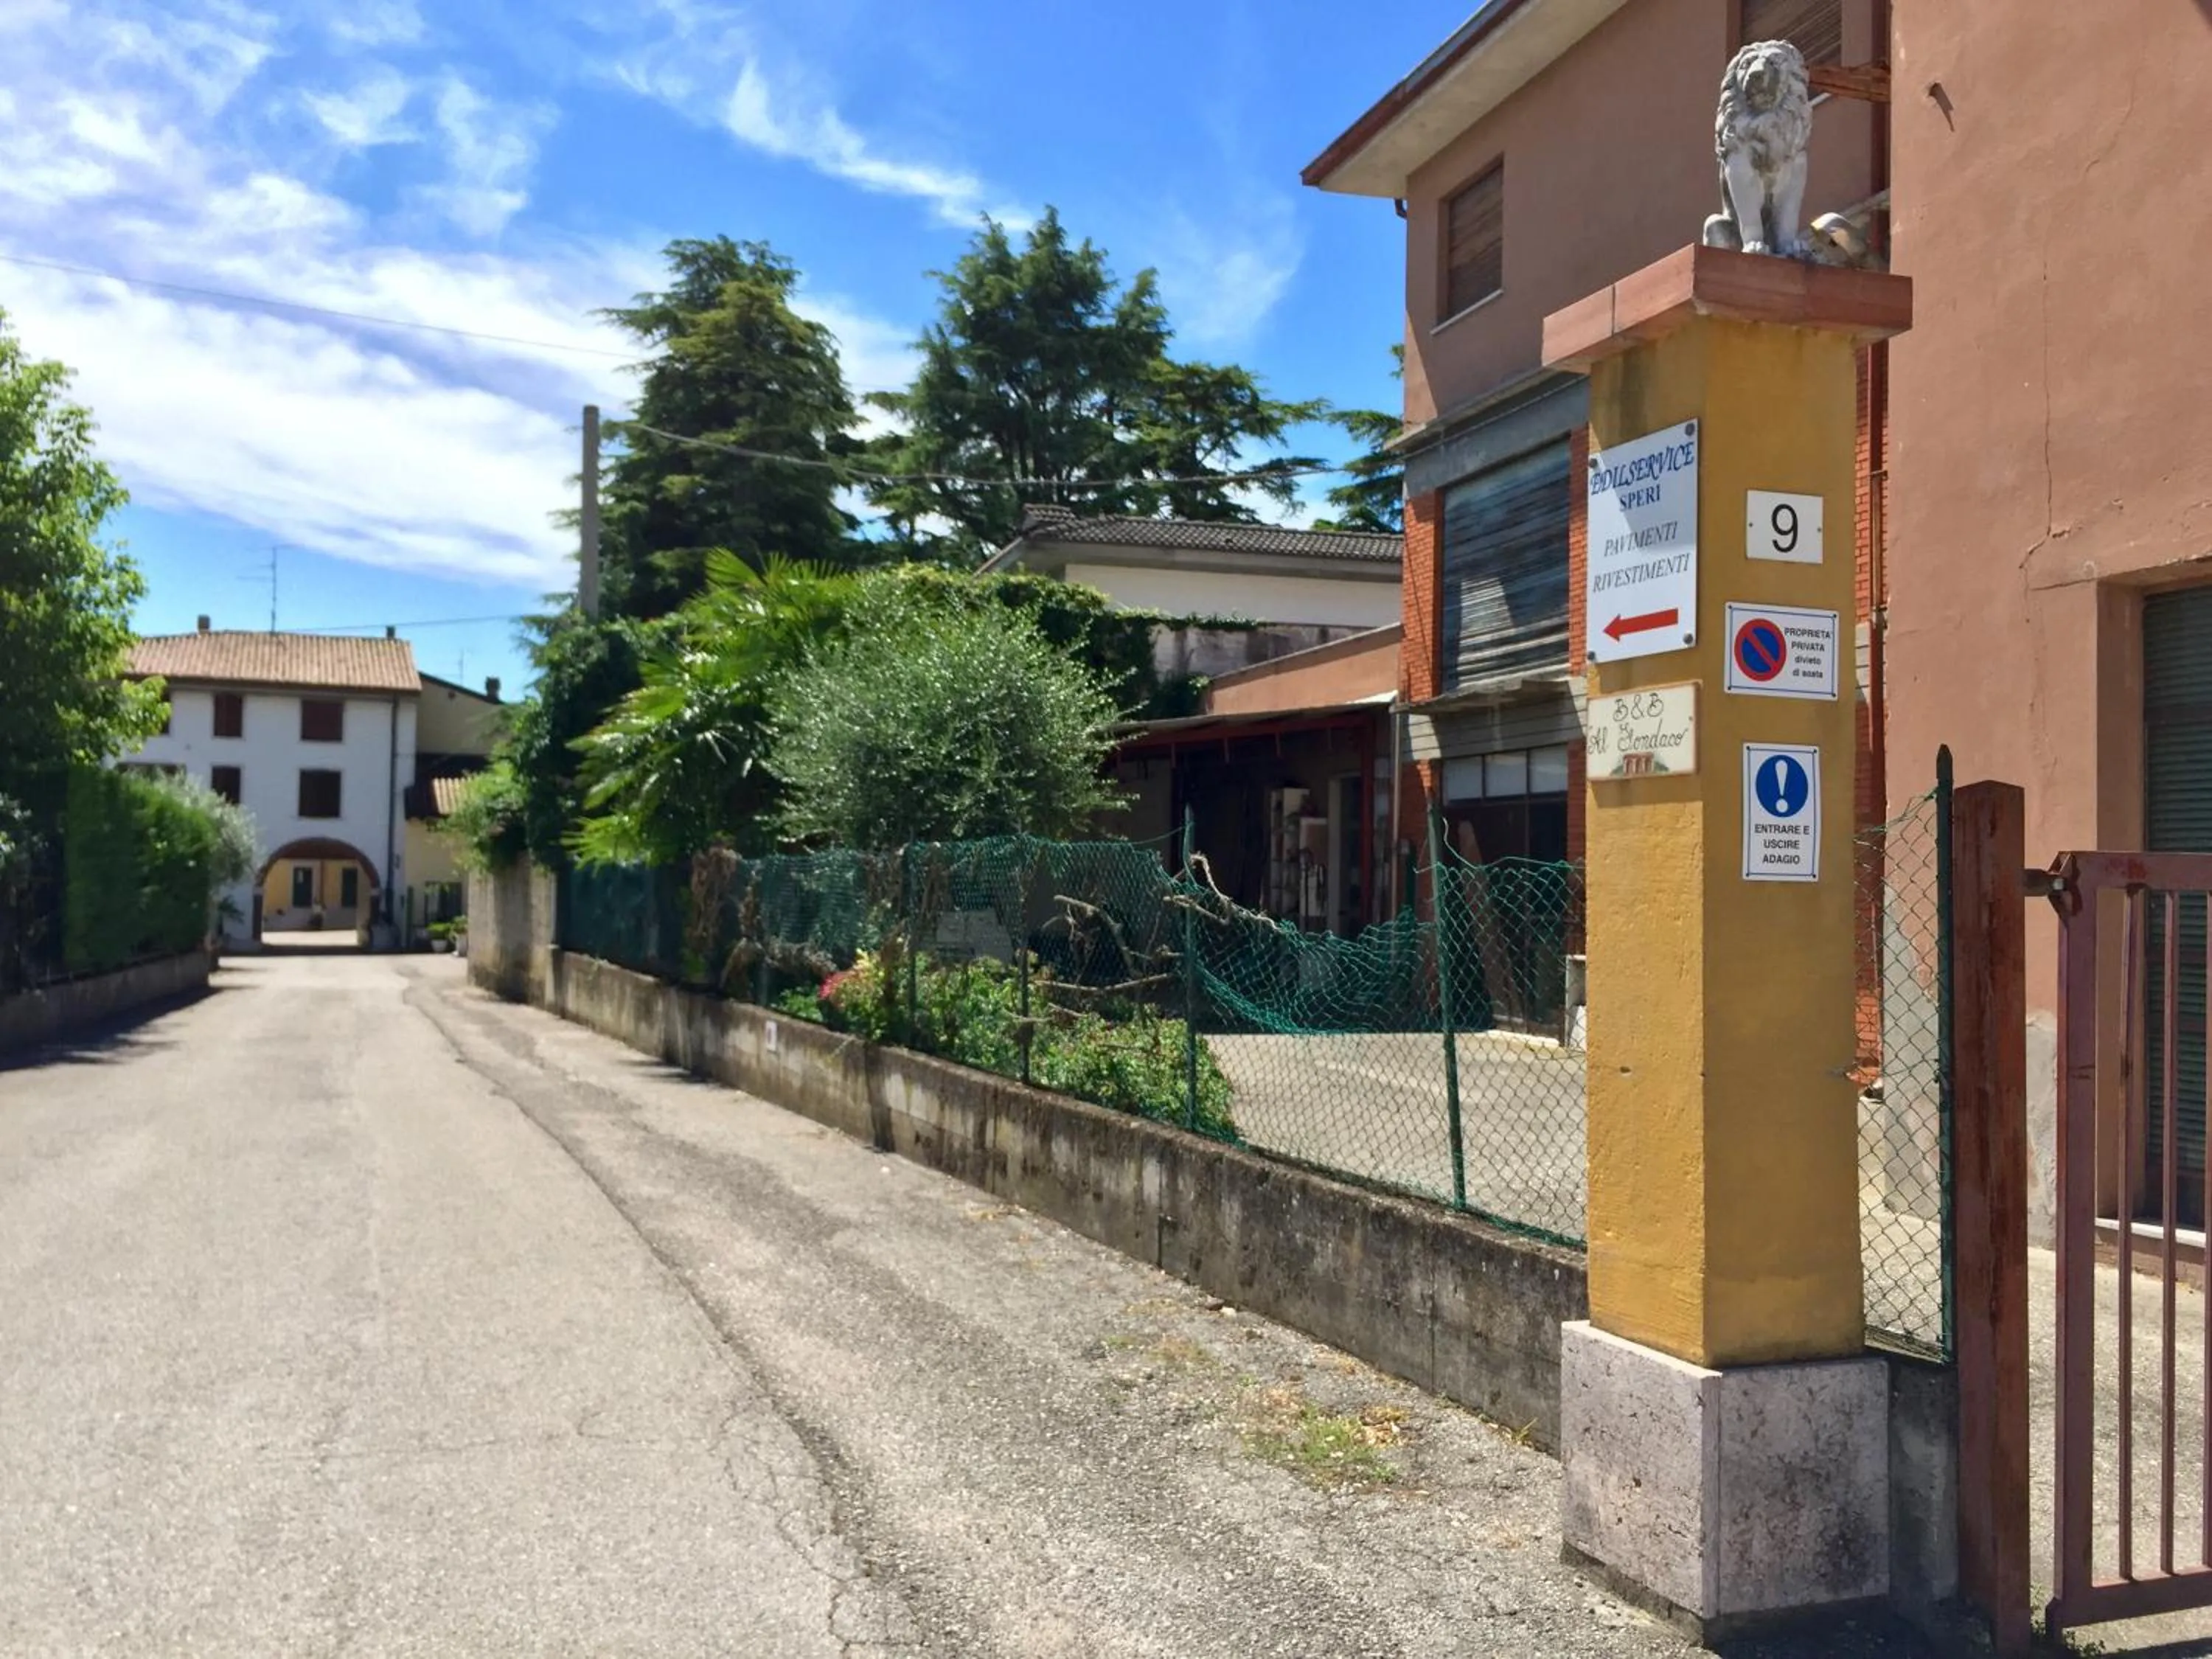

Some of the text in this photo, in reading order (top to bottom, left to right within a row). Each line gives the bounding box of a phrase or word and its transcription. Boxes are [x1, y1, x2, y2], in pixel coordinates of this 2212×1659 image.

[1590, 442, 1694, 495] EDILSERVICE
[1619, 484, 1660, 511] SPERI
[1771, 504, 1798, 553] 9
[1593, 553, 1690, 593] RIVESTIMENTI
[1791, 641, 1825, 652] PRIVATA
[1613, 692, 1664, 722] B&B
[1754, 824, 1810, 835] ENTRARE E
[1763, 840, 1800, 849] USCIRE
[1761, 855, 1801, 865] ADAGIO
